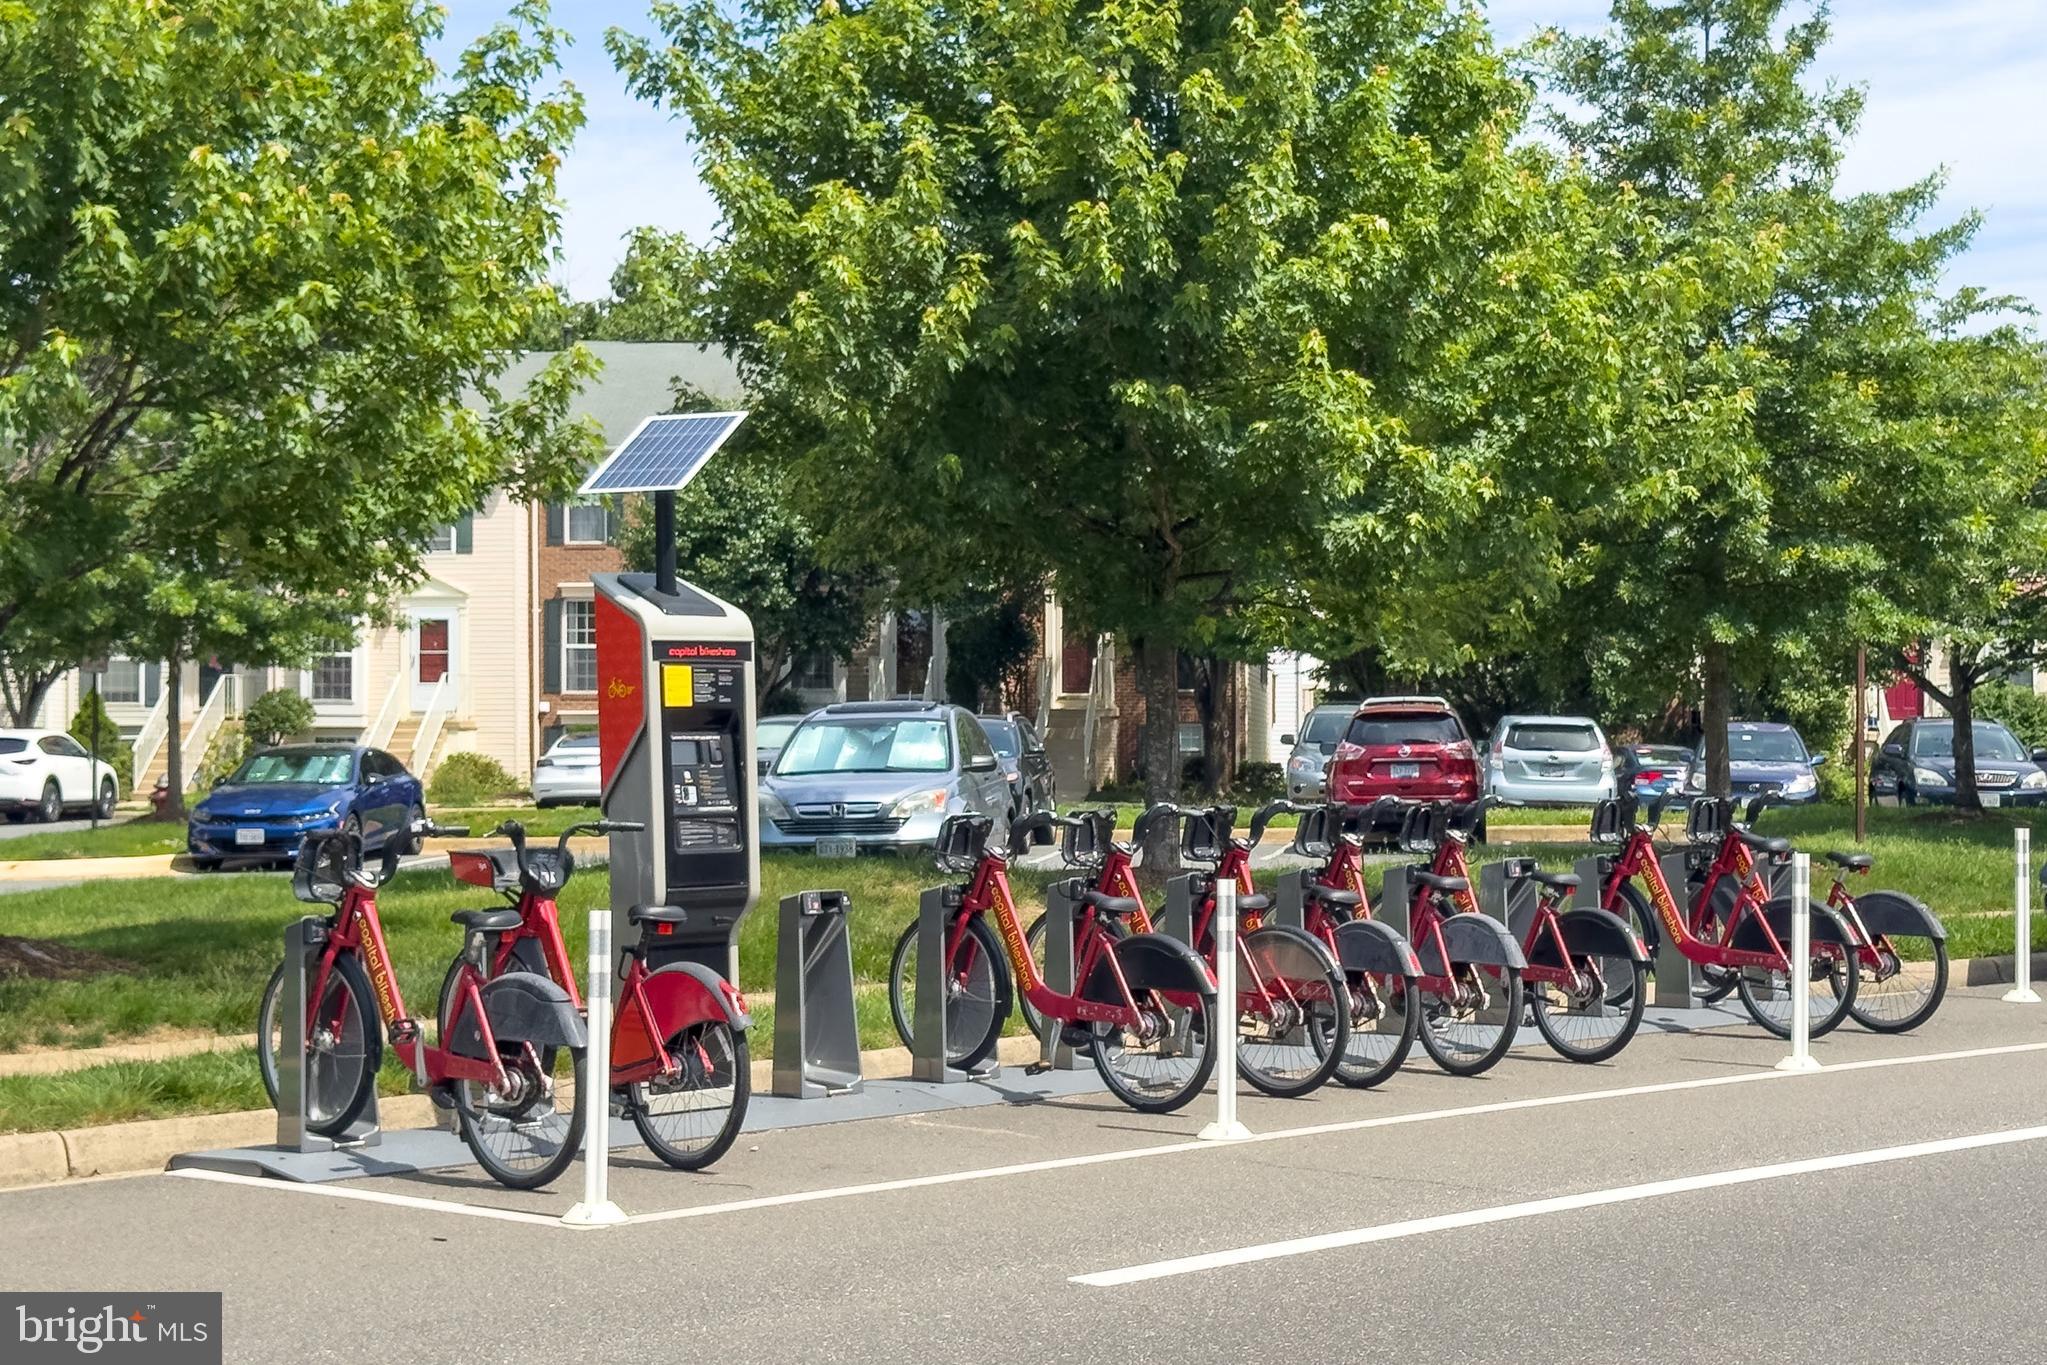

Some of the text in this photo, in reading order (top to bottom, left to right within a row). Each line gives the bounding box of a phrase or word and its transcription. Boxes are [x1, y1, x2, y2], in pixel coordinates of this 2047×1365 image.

[700, 645, 737, 656] bikeshare
[991, 887, 1032, 991] capital bikeshare
[1641, 859, 1681, 944] capital bikeshare
[360, 919, 397, 1025] capital bikesh
